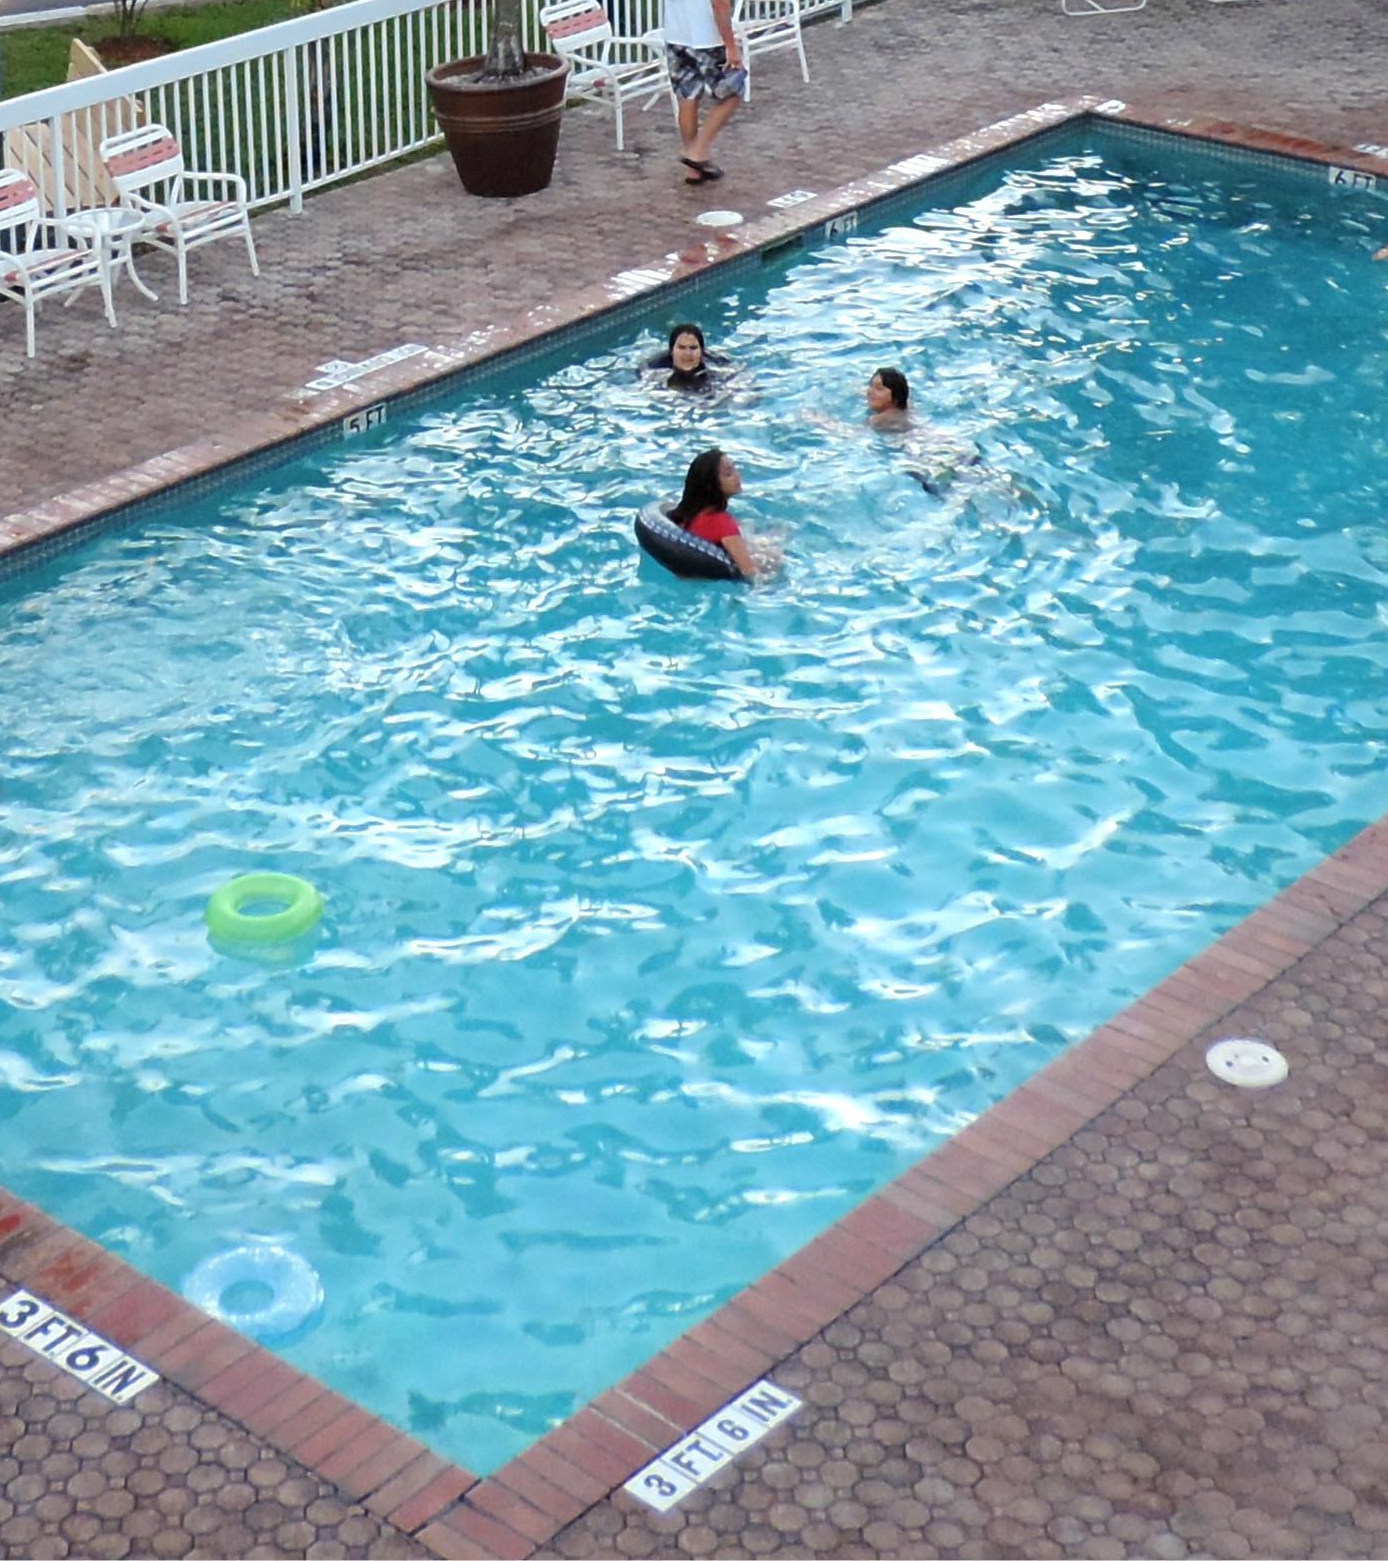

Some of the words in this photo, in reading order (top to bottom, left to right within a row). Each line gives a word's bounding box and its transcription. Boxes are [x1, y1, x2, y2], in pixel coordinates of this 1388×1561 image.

[366, 405, 384, 431] FT
[66, 1345, 109, 1371] 6
[644, 1474, 678, 1497] 3
[717, 1419, 750, 1441] 6
